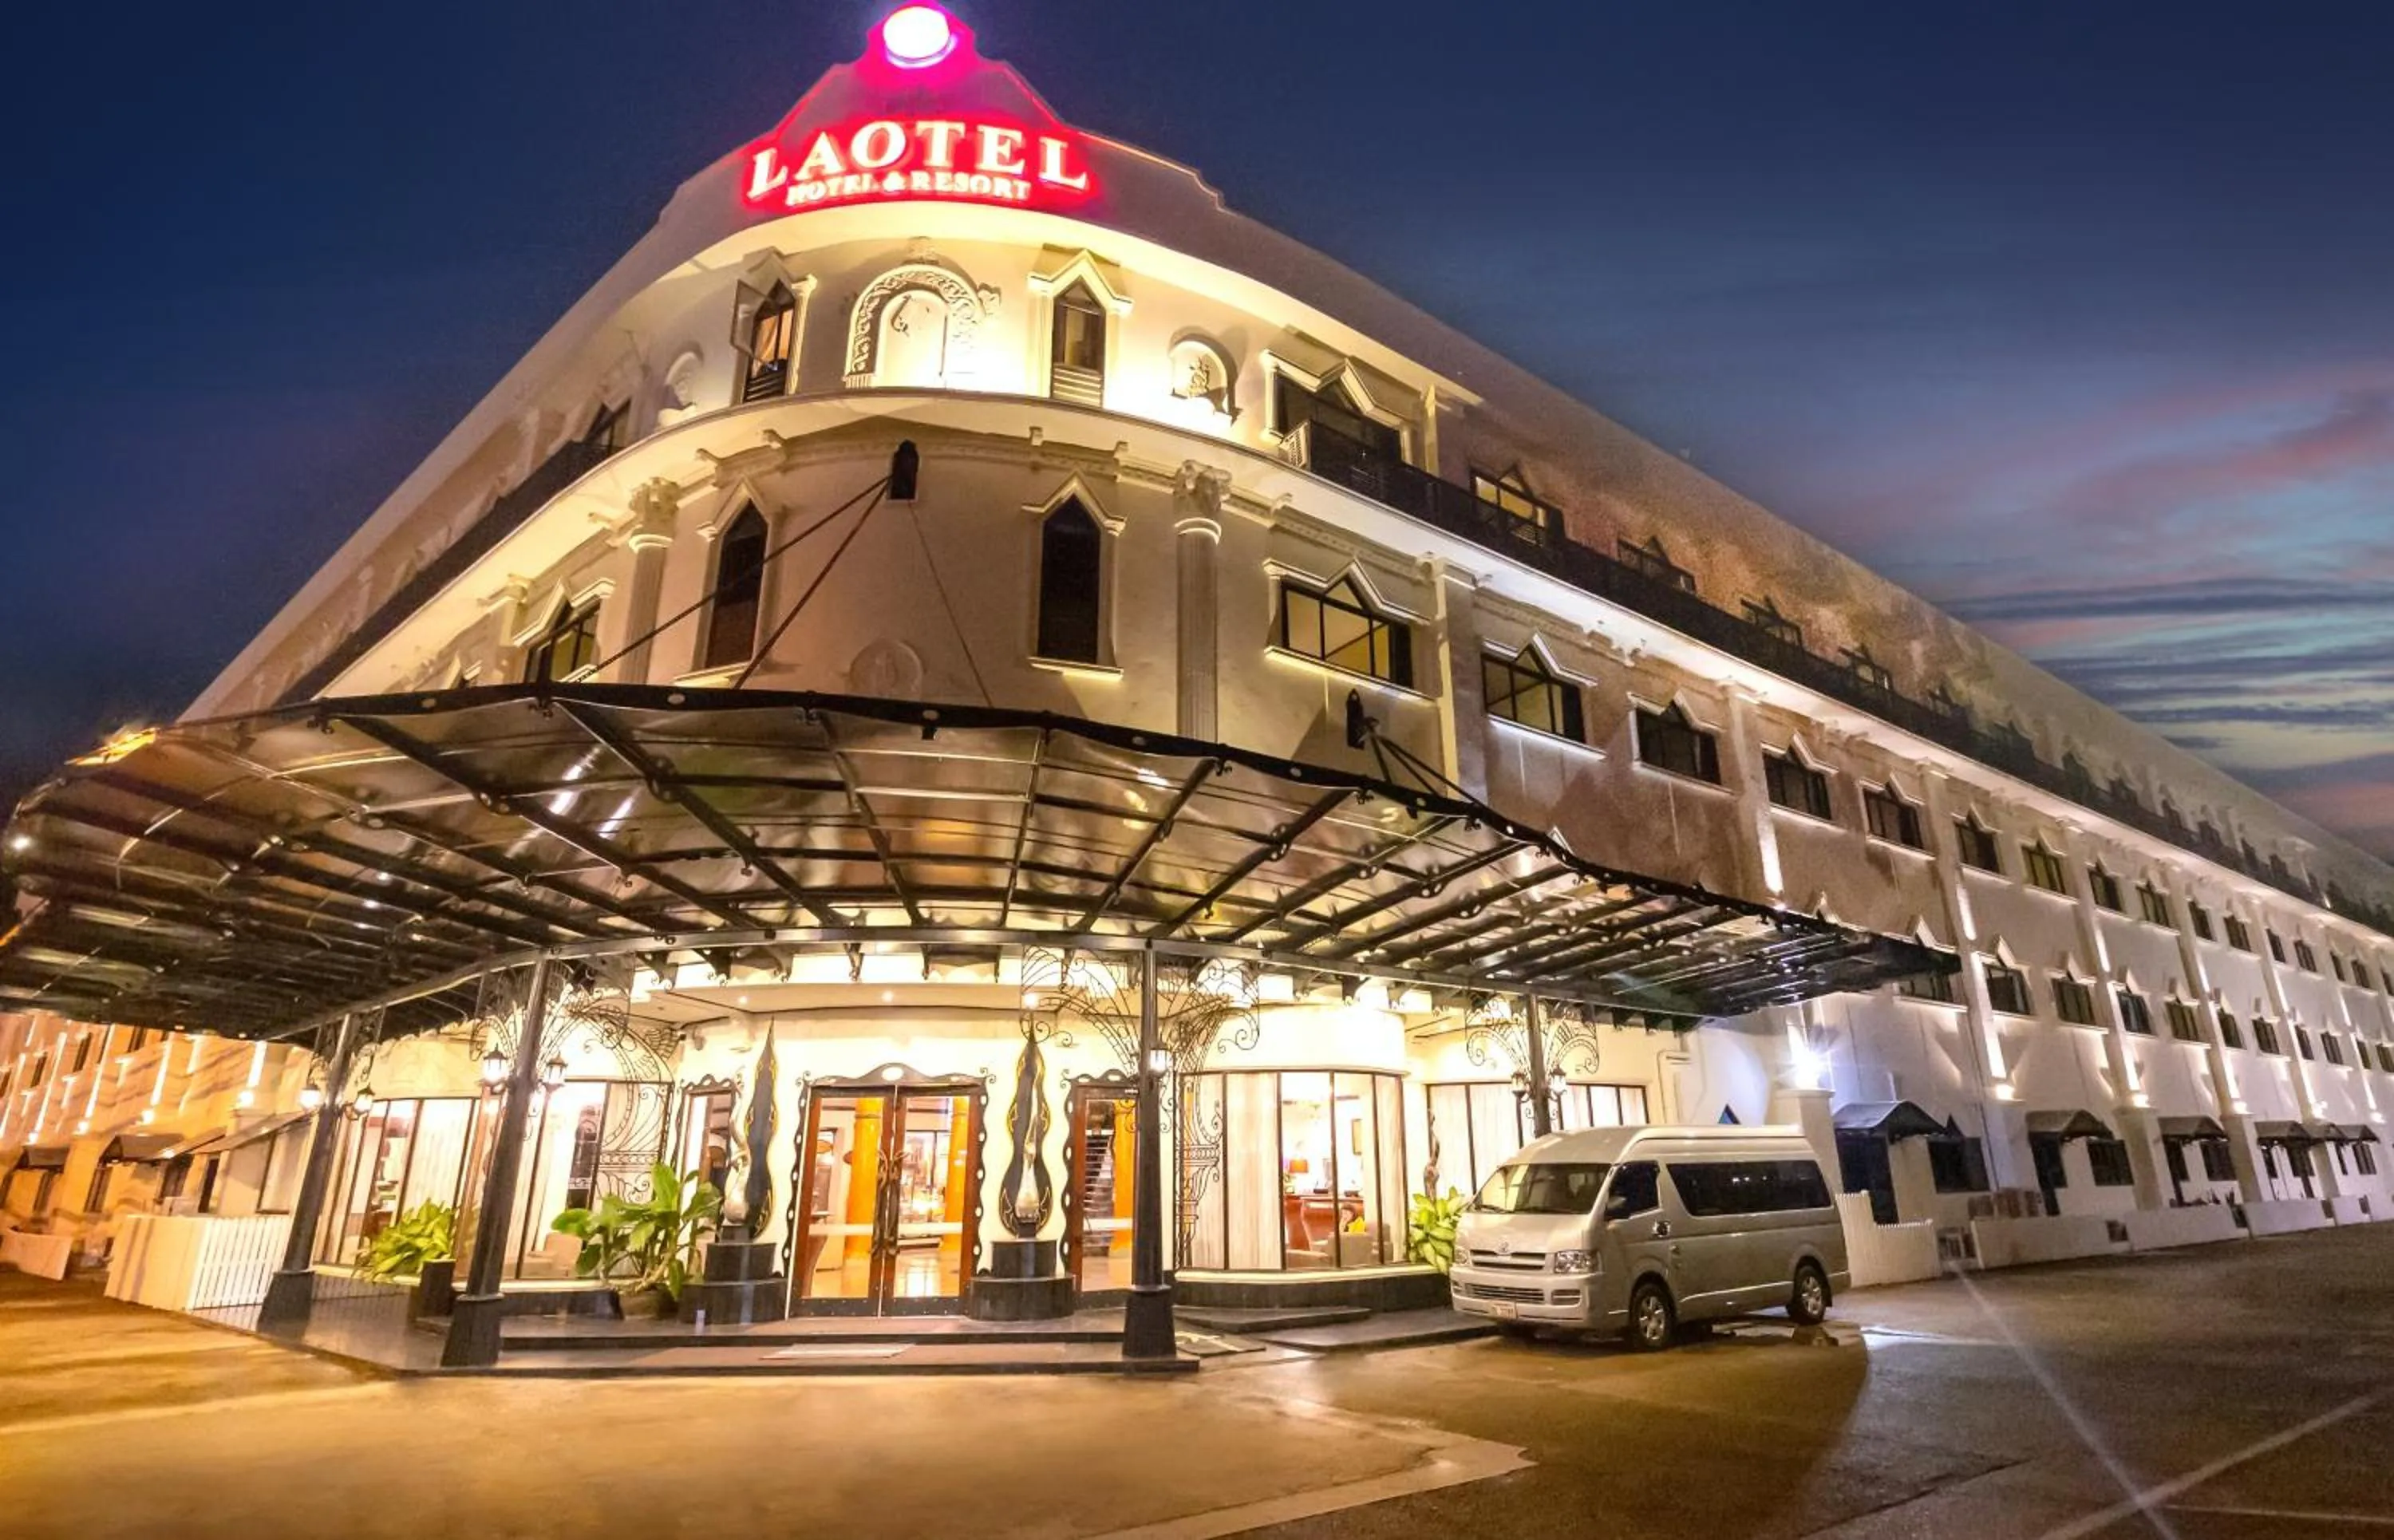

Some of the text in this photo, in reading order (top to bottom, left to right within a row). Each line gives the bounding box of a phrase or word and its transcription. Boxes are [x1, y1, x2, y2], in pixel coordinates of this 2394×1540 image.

[747, 120, 1088, 199] LAOTEL
[785, 173, 880, 206] HOTEL
[910, 170, 1032, 200] RESORT
